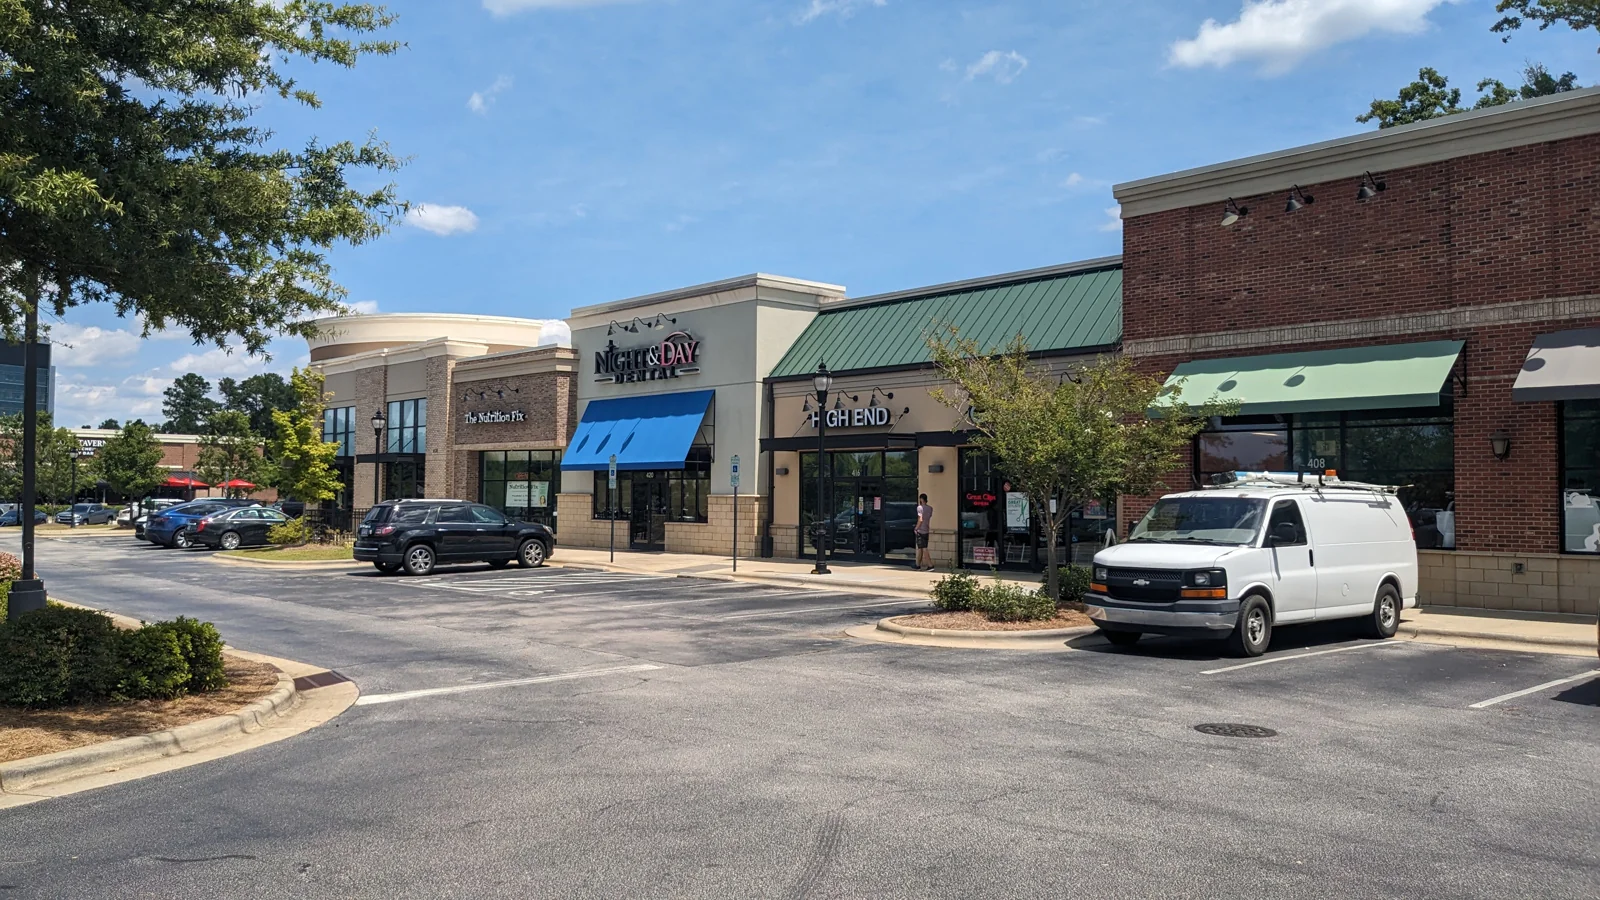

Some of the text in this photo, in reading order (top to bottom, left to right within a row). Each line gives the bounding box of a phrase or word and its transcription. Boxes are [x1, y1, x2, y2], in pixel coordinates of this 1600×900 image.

[614, 366, 679, 384] DENTAL
[465, 410, 525, 424] The Nutrition Fix
[811, 407, 889, 428] HGH END
[1307, 458, 1325, 469] 408
